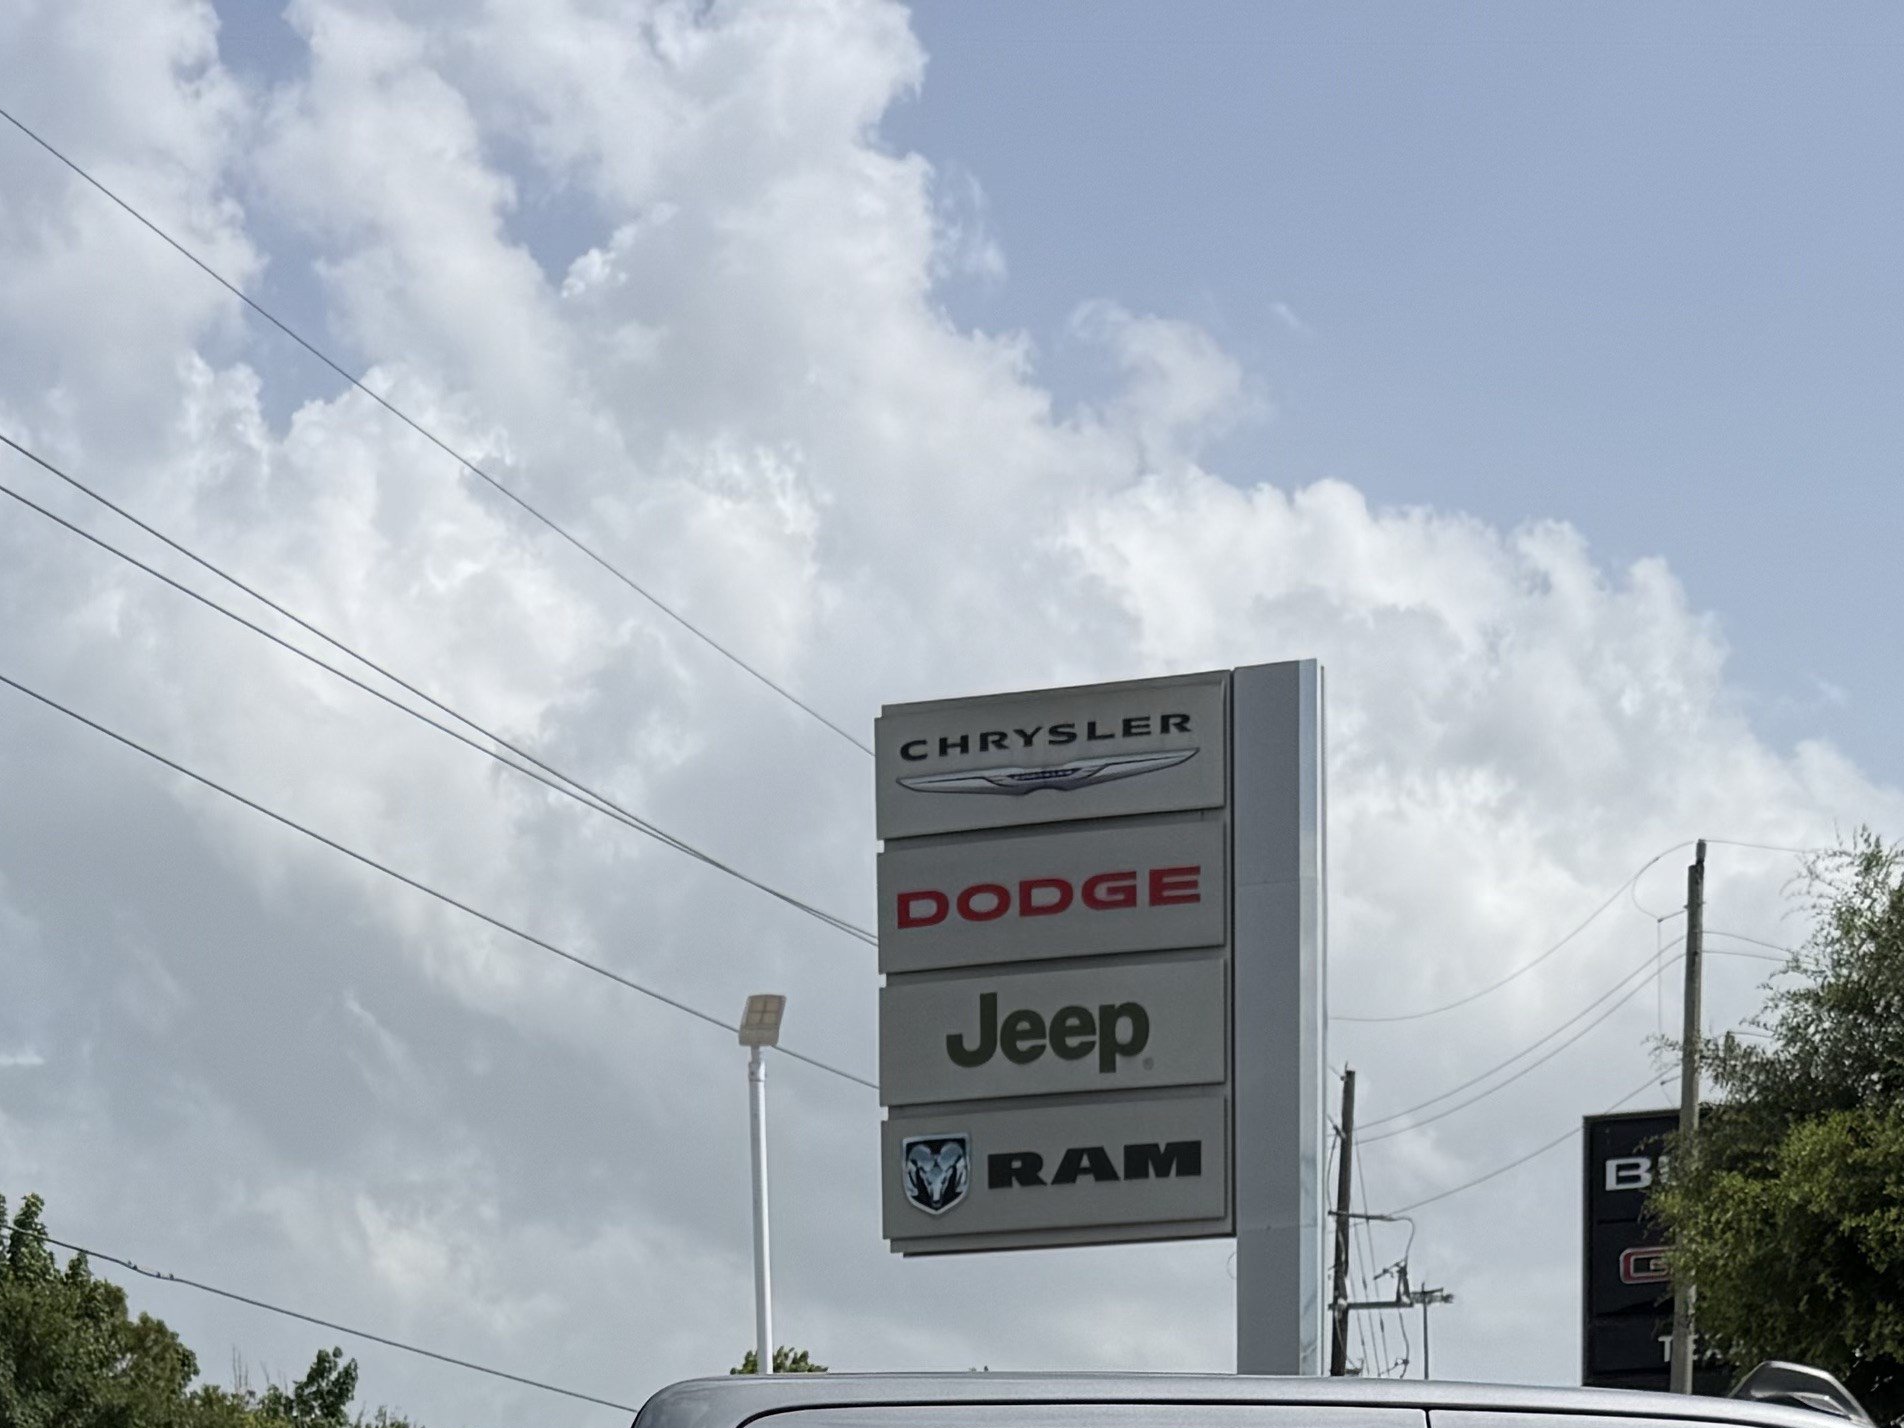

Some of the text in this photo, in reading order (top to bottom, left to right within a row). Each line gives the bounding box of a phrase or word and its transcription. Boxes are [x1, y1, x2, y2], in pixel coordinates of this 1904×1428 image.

[900, 713, 1192, 761] CHRYSLER
[897, 865, 1201, 929] DODGE
[946, 992, 1150, 1074] Jeep
[987, 1140, 1202, 1189] RAM
